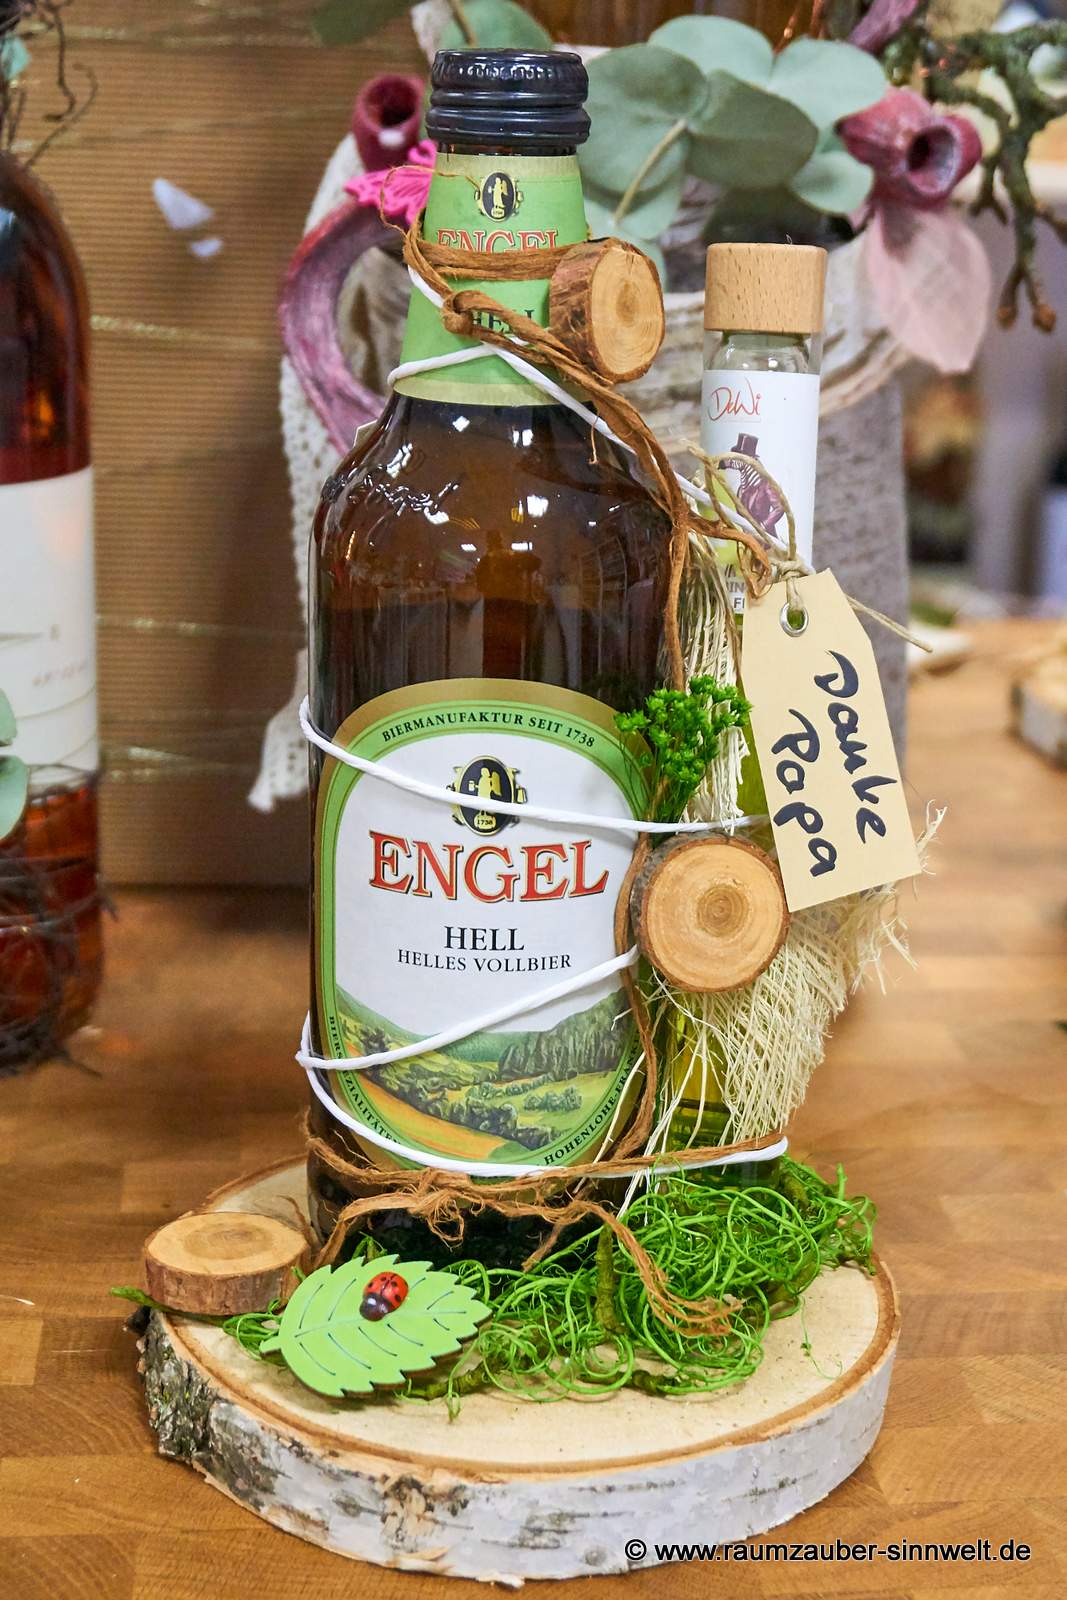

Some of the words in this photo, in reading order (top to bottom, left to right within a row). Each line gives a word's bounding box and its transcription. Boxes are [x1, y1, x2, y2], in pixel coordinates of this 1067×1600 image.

[382, 711, 524, 743] BIERMANUFAKTUR
[528, 716, 564, 734] SEIT
[565, 726, 596, 749] 1738
[814, 650, 897, 844] Danke
[772, 709, 837, 877] Papa
[369, 829, 609, 903] ENGEL
[397, 949, 467, 972] HELLES
[473, 953, 572, 973] VOLLBIER
[444, 926, 525, 951] HELL
